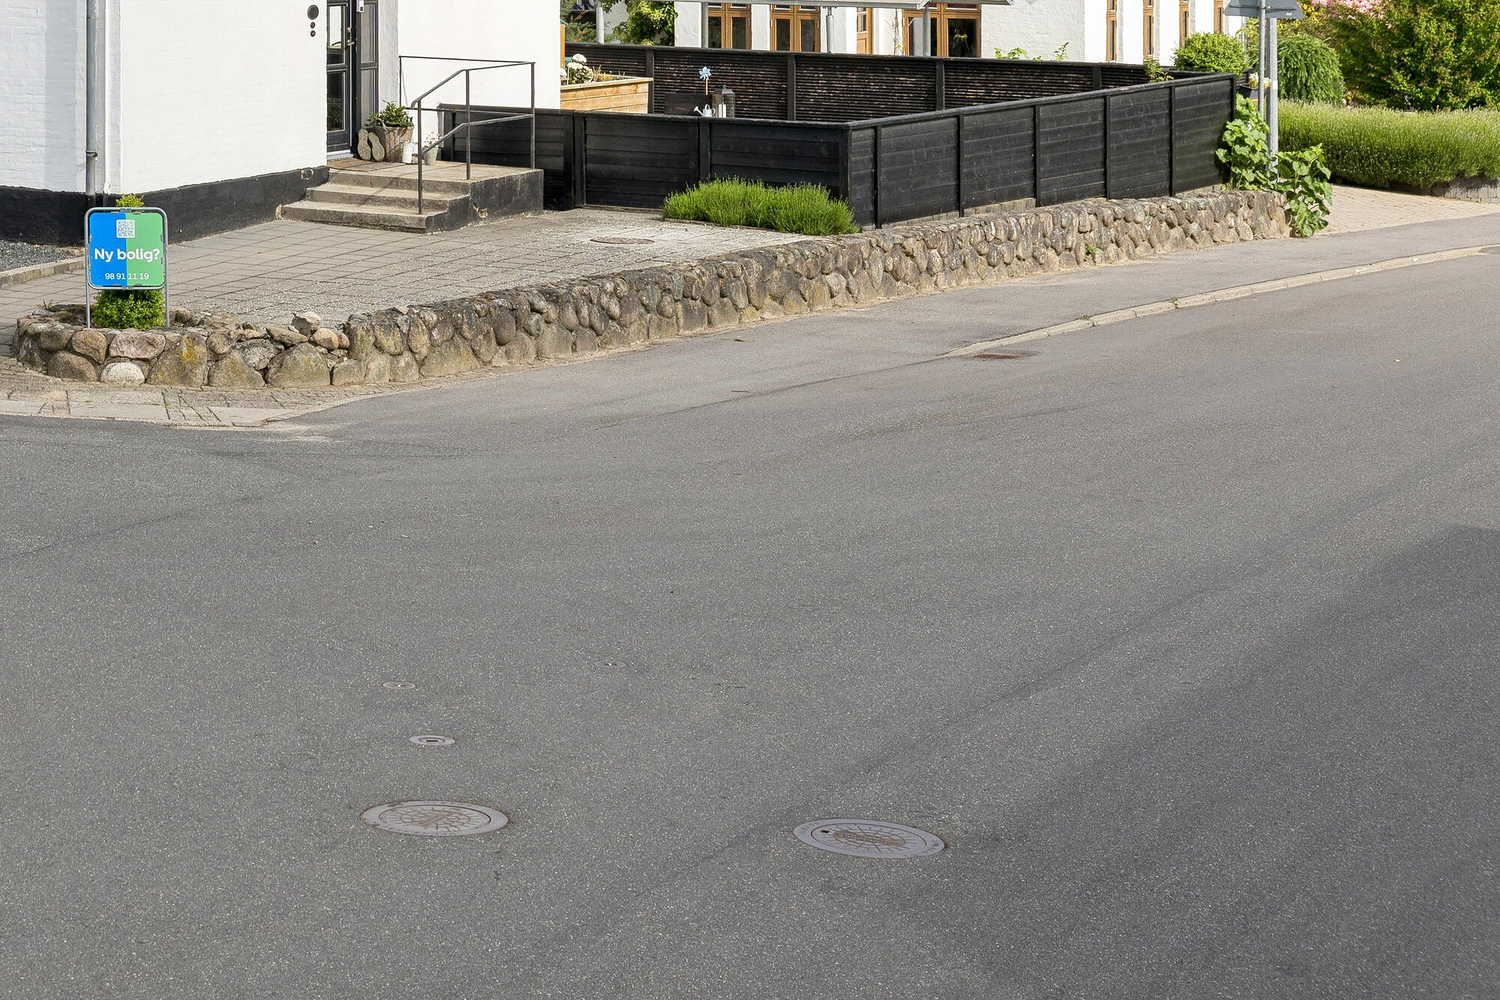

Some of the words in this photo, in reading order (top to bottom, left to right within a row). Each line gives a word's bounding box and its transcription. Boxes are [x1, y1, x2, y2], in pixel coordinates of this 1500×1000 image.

[94, 248, 114, 262] Ny
[117, 248, 160, 262] bolig?
[104, 272, 115, 280] 98
[116, 272, 126, 280] 91
[128, 272, 137, 280] 11
[139, 272, 150, 280] 19
